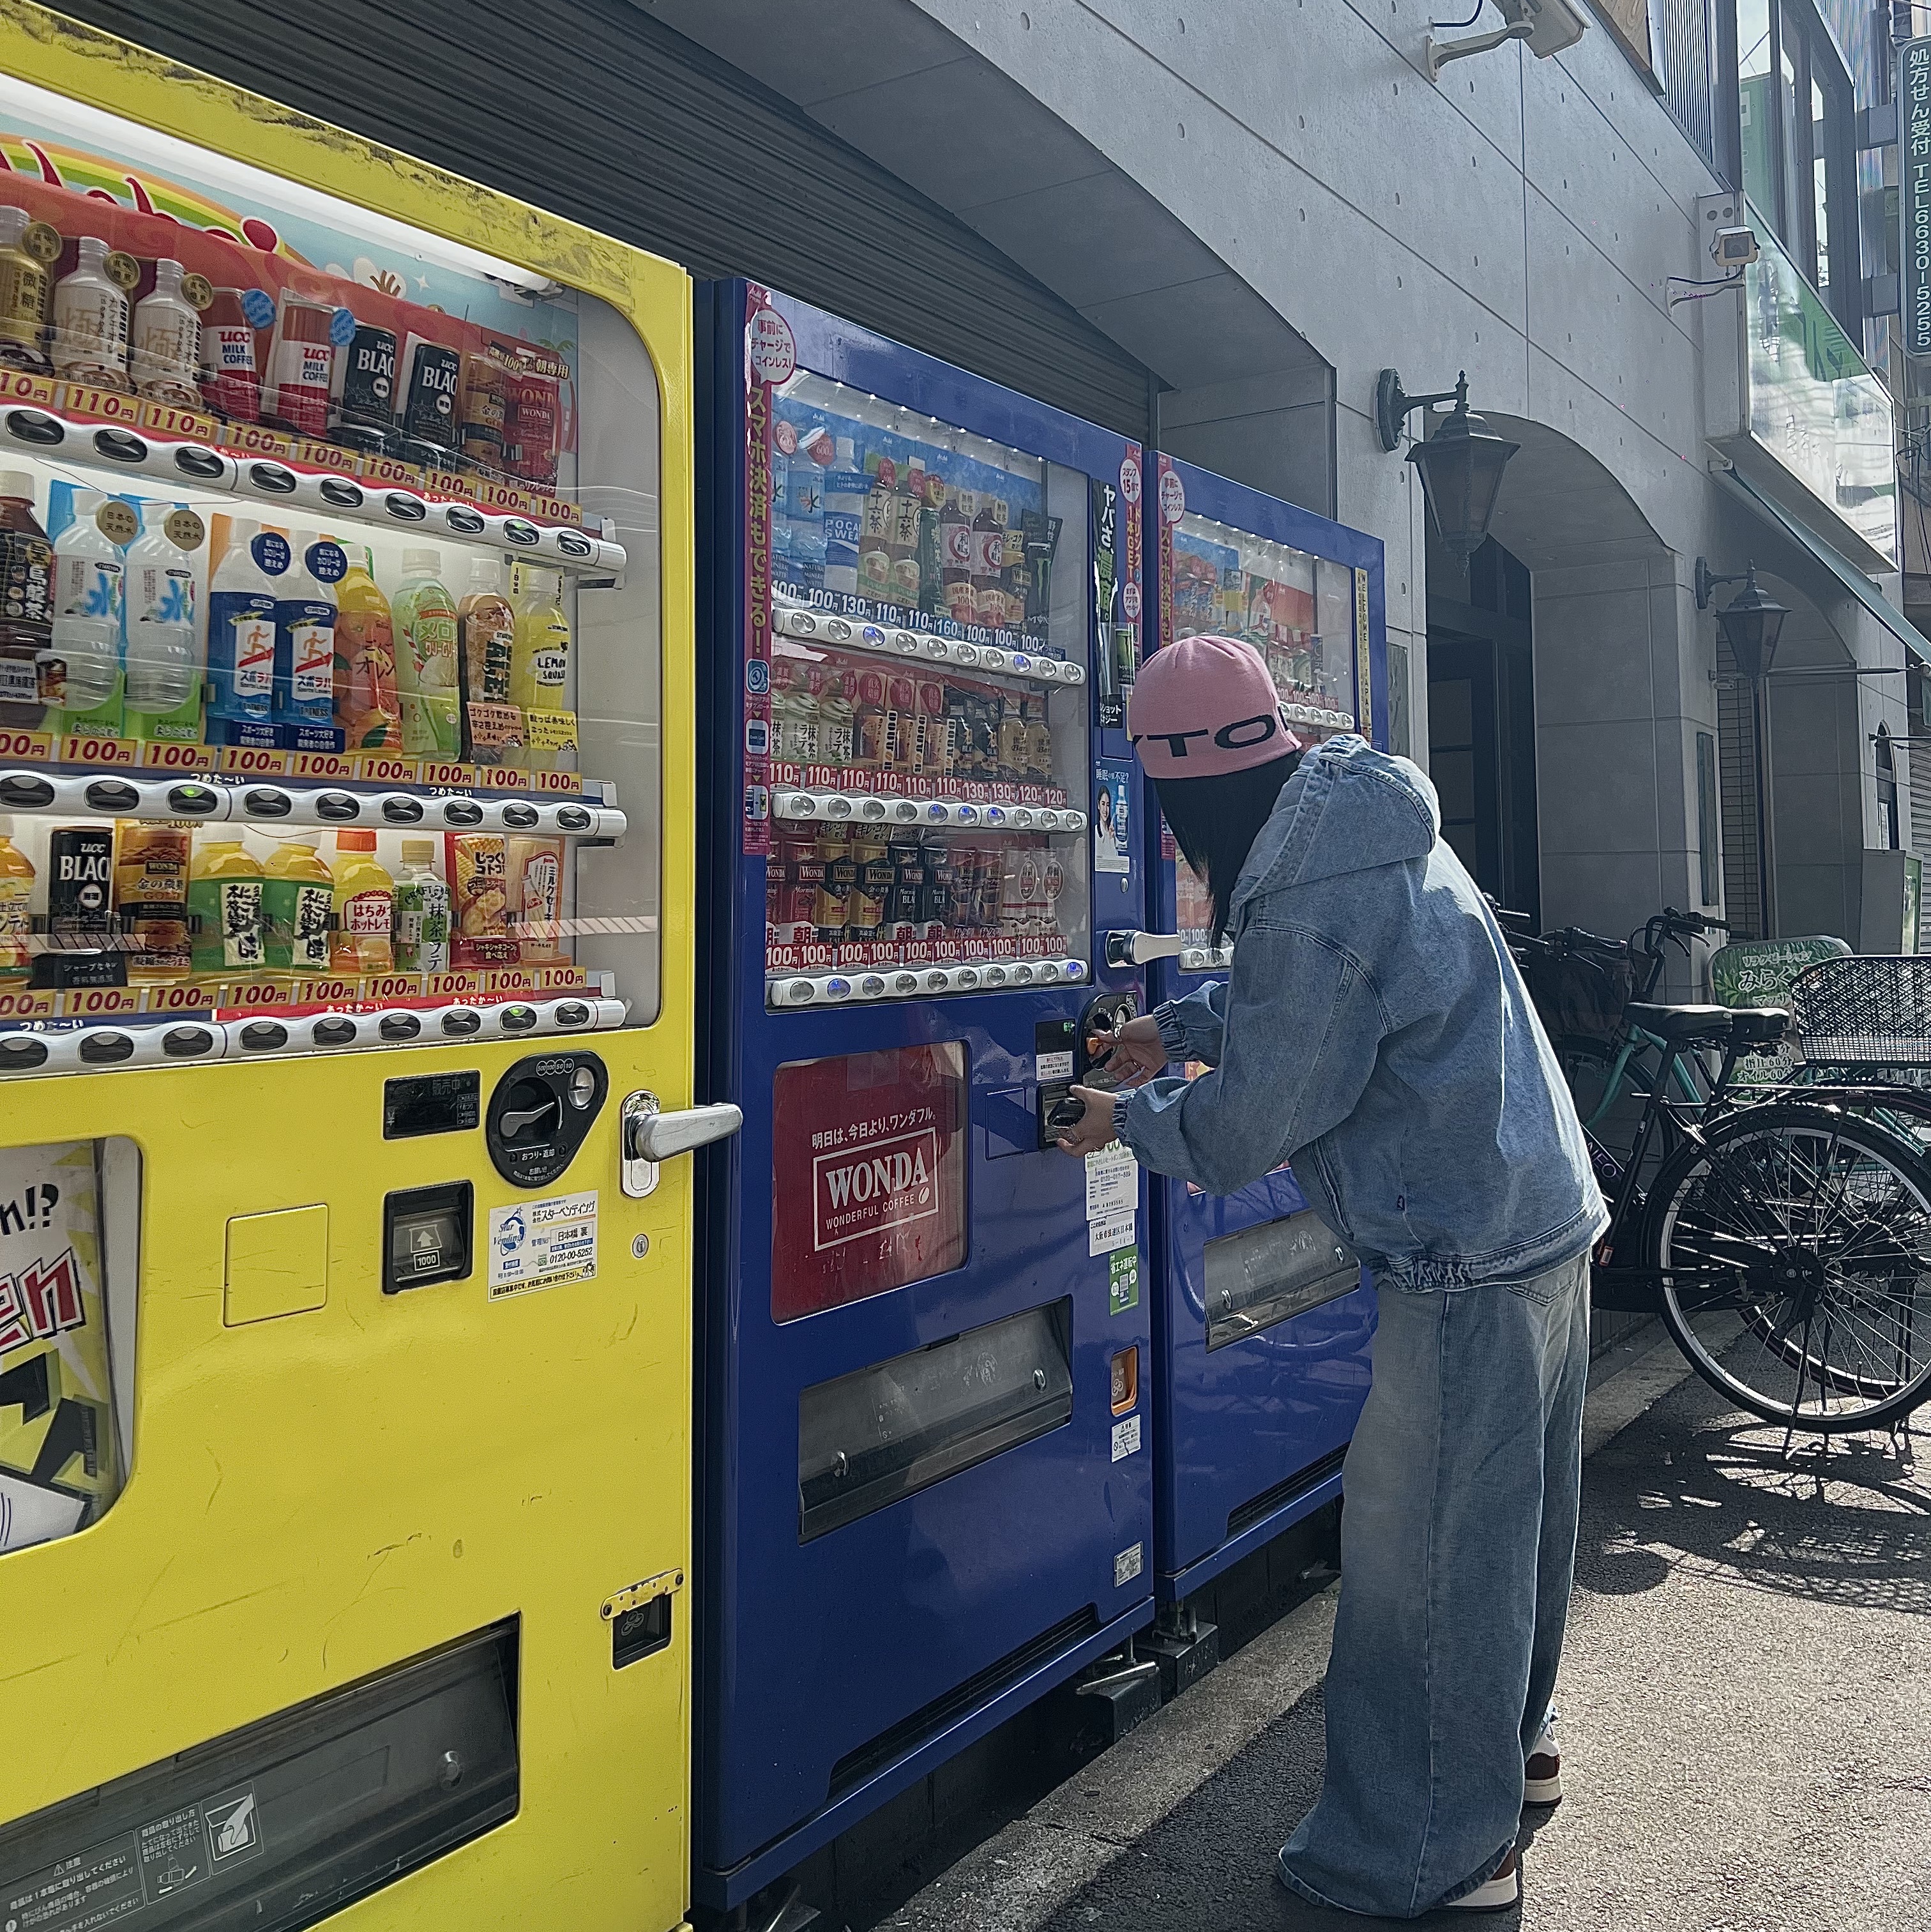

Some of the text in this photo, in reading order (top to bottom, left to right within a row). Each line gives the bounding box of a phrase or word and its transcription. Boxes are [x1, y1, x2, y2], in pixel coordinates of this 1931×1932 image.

[1909, 49, 1931, 156] 処方せん受付
[757, 319, 784, 336] 事前に
[222, 344, 245, 354] MILK
[751, 337, 791, 353] チャージで
[303, 361, 324, 373] MILK
[536, 359, 568, 379] 朝専用
[74, 389, 133, 420] 110円
[153, 408, 208, 436] 110円
[234, 426, 285, 454] 100円
[303, 443, 352, 469] 100円
[368, 458, 414, 484] 100円
[431, 473, 473, 497] 100円
[487, 486, 528, 510] 100円
[107, 512, 133, 524] 日本の
[541, 499, 579, 522] 100円
[868, 491, 882, 533] 十六茶
[899, 500, 912, 541] 十六茶
[105, 522, 134, 535] 天然水
[174, 519, 201, 529] 日本の
[173, 531, 202, 541] 天然水
[824, 529, 859, 542] SWEA
[69, 738, 130, 761] 100円
[807, 725, 817, 759] 抹茶
[842, 728, 852, 761] 抹茶
[152, 745, 208, 766] 100円
[229, 750, 282, 771] 100円
[301, 755, 349, 775] 100円
[367, 760, 413, 780] 100円
[428, 764, 471, 784] 100円
[486, 769, 526, 787] 100円
[540, 773, 579, 791] 100円
[475, 864, 504, 875] コトコ
[801, 866, 824, 878] WONDA
[544, 866, 556, 921] ミルクセーキ
[350, 919, 390, 931] ホットレモ
[428, 903, 445, 971] 抹茶ラテ
[371, 978, 417, 997] 100円
[433, 975, 476, 993] 100円
[491, 971, 531, 990] 100円
[545, 969, 583, 986] 100円
[72, 991, 133, 1012] 100円
[156, 987, 213, 1008] 100円
[233, 985, 287, 1005] 100円
[305, 982, 354, 1001] 100円
[432, 1078, 460, 1097] 販売中
[812, 1106, 937, 1150] 明日は、今日より、ワンダフル。
[522, 1148, 555, 1162] おつり・返却
[826, 1147, 928, 1210] WONDA
[826, 1194, 914, 1230] WONDERFUL COFFEE
[499, 1224, 514, 1233] Star
[494, 1234, 522, 1245] Vending
[417, 1255, 437, 1267] 1000
[550, 1247, 593, 1264] 0120-00-5252
[141, 1809, 195, 1838] 商品の取り出し方
